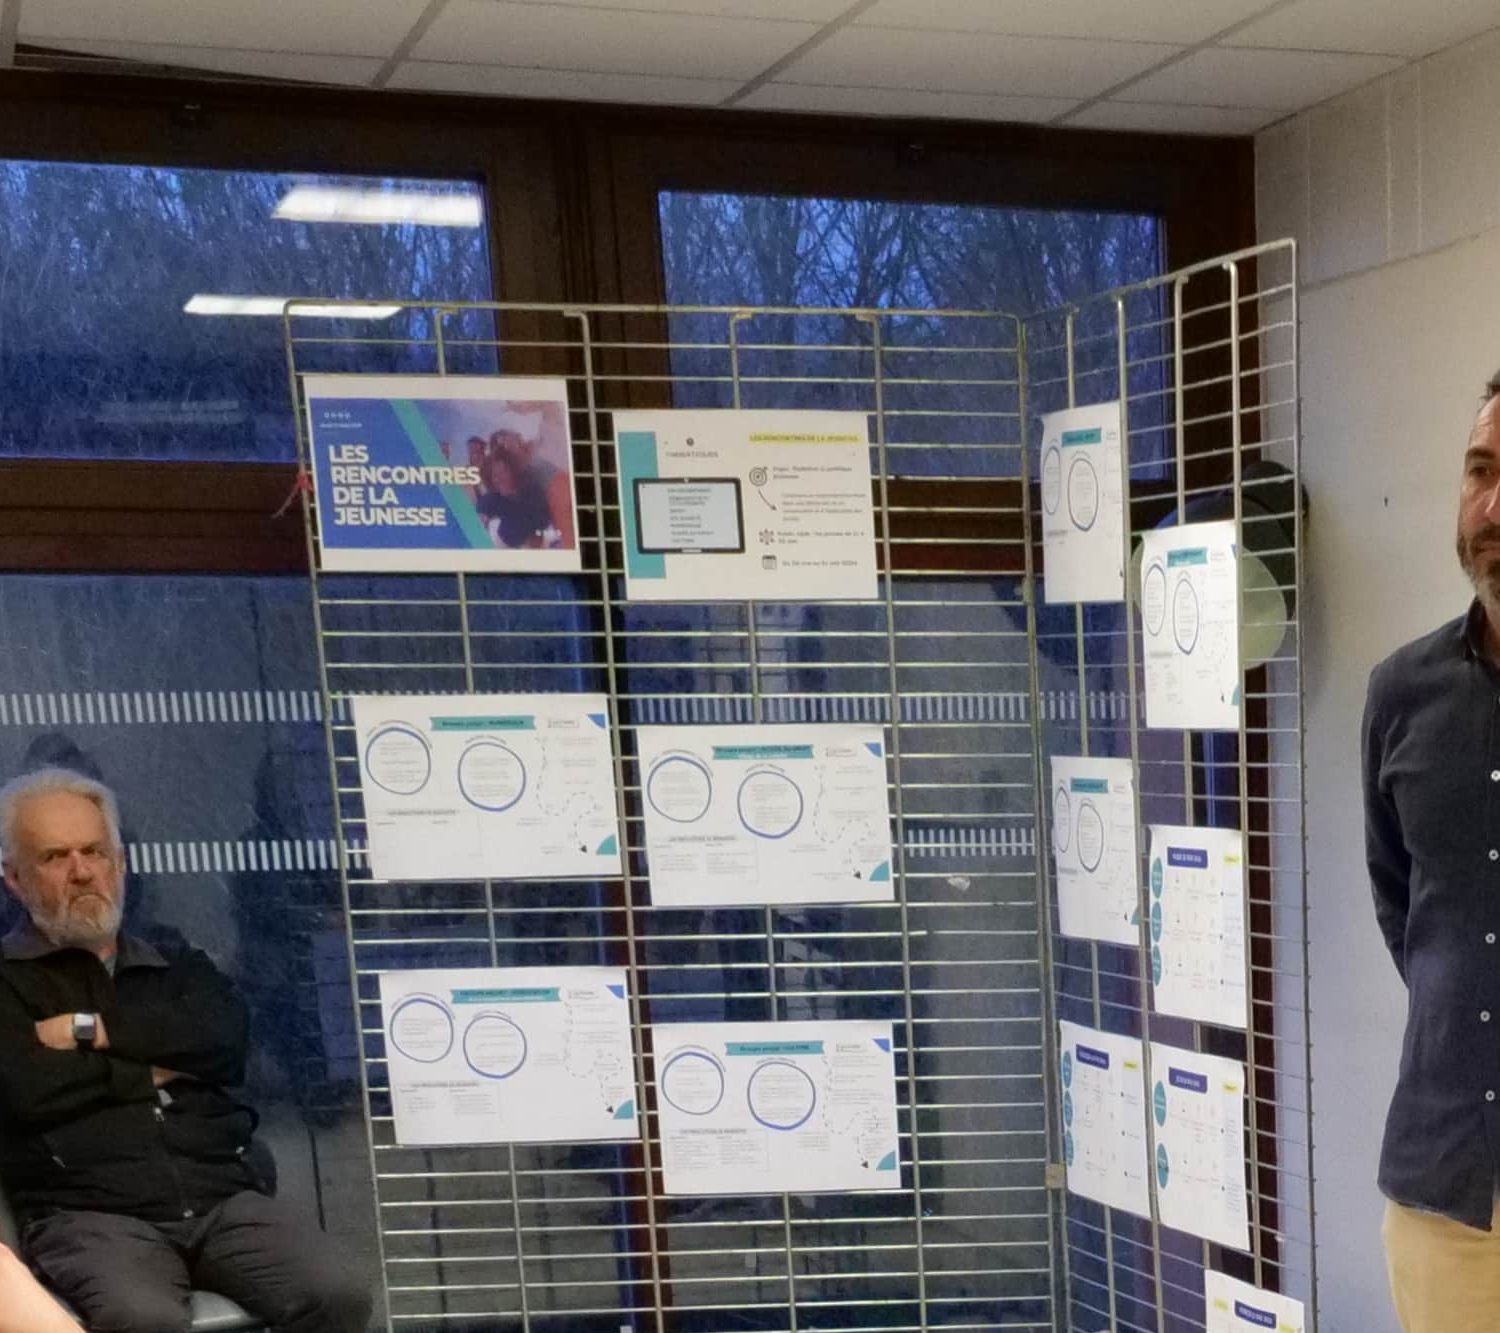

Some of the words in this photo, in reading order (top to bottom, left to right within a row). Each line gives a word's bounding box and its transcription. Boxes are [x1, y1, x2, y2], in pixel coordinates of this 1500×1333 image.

[328, 445, 369, 464] LES
[330, 466, 481, 485] RENCONTRES
[332, 486, 365, 505] DE
[368, 486, 400, 505] LA
[333, 507, 448, 527] JEUNESSE
